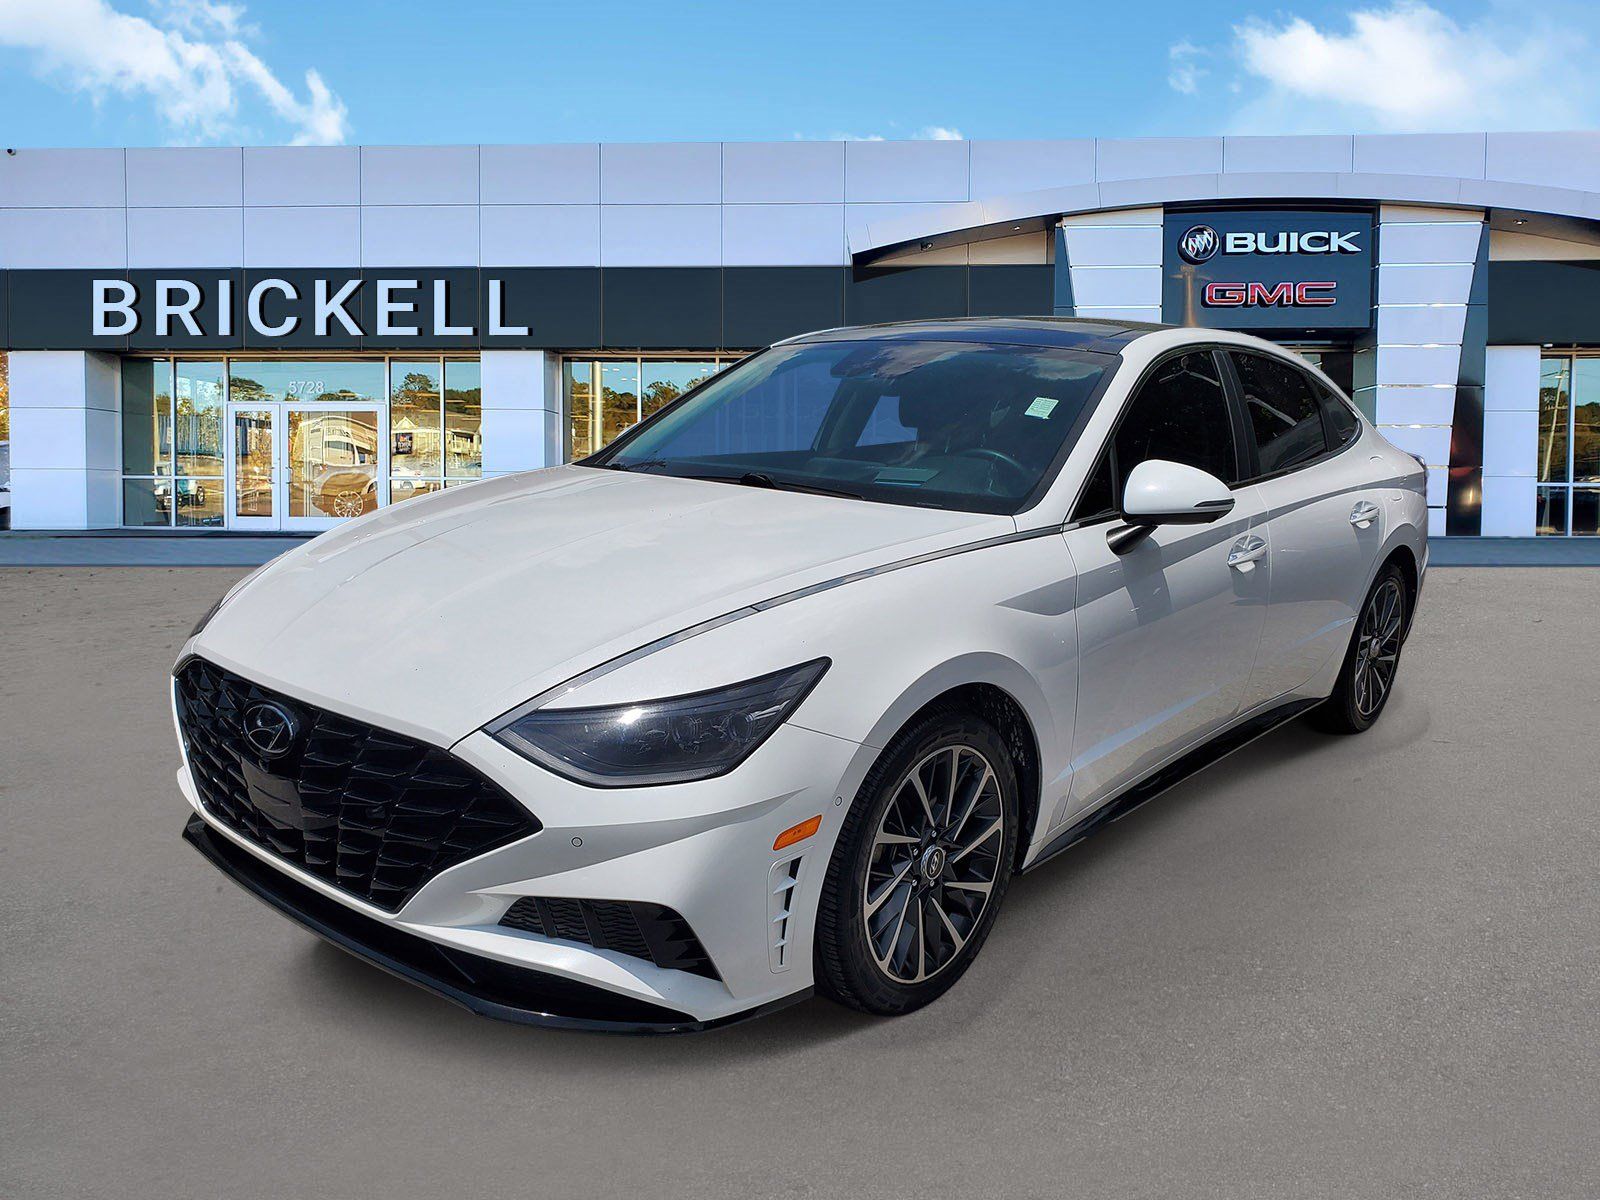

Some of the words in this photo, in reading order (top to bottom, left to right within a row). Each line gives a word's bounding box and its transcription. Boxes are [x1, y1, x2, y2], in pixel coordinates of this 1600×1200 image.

[1225, 231, 1362, 253] BUICK
[1204, 281, 1337, 305] GMC
[91, 278, 531, 337] BRICKELL
[288, 380, 325, 394] 5728
